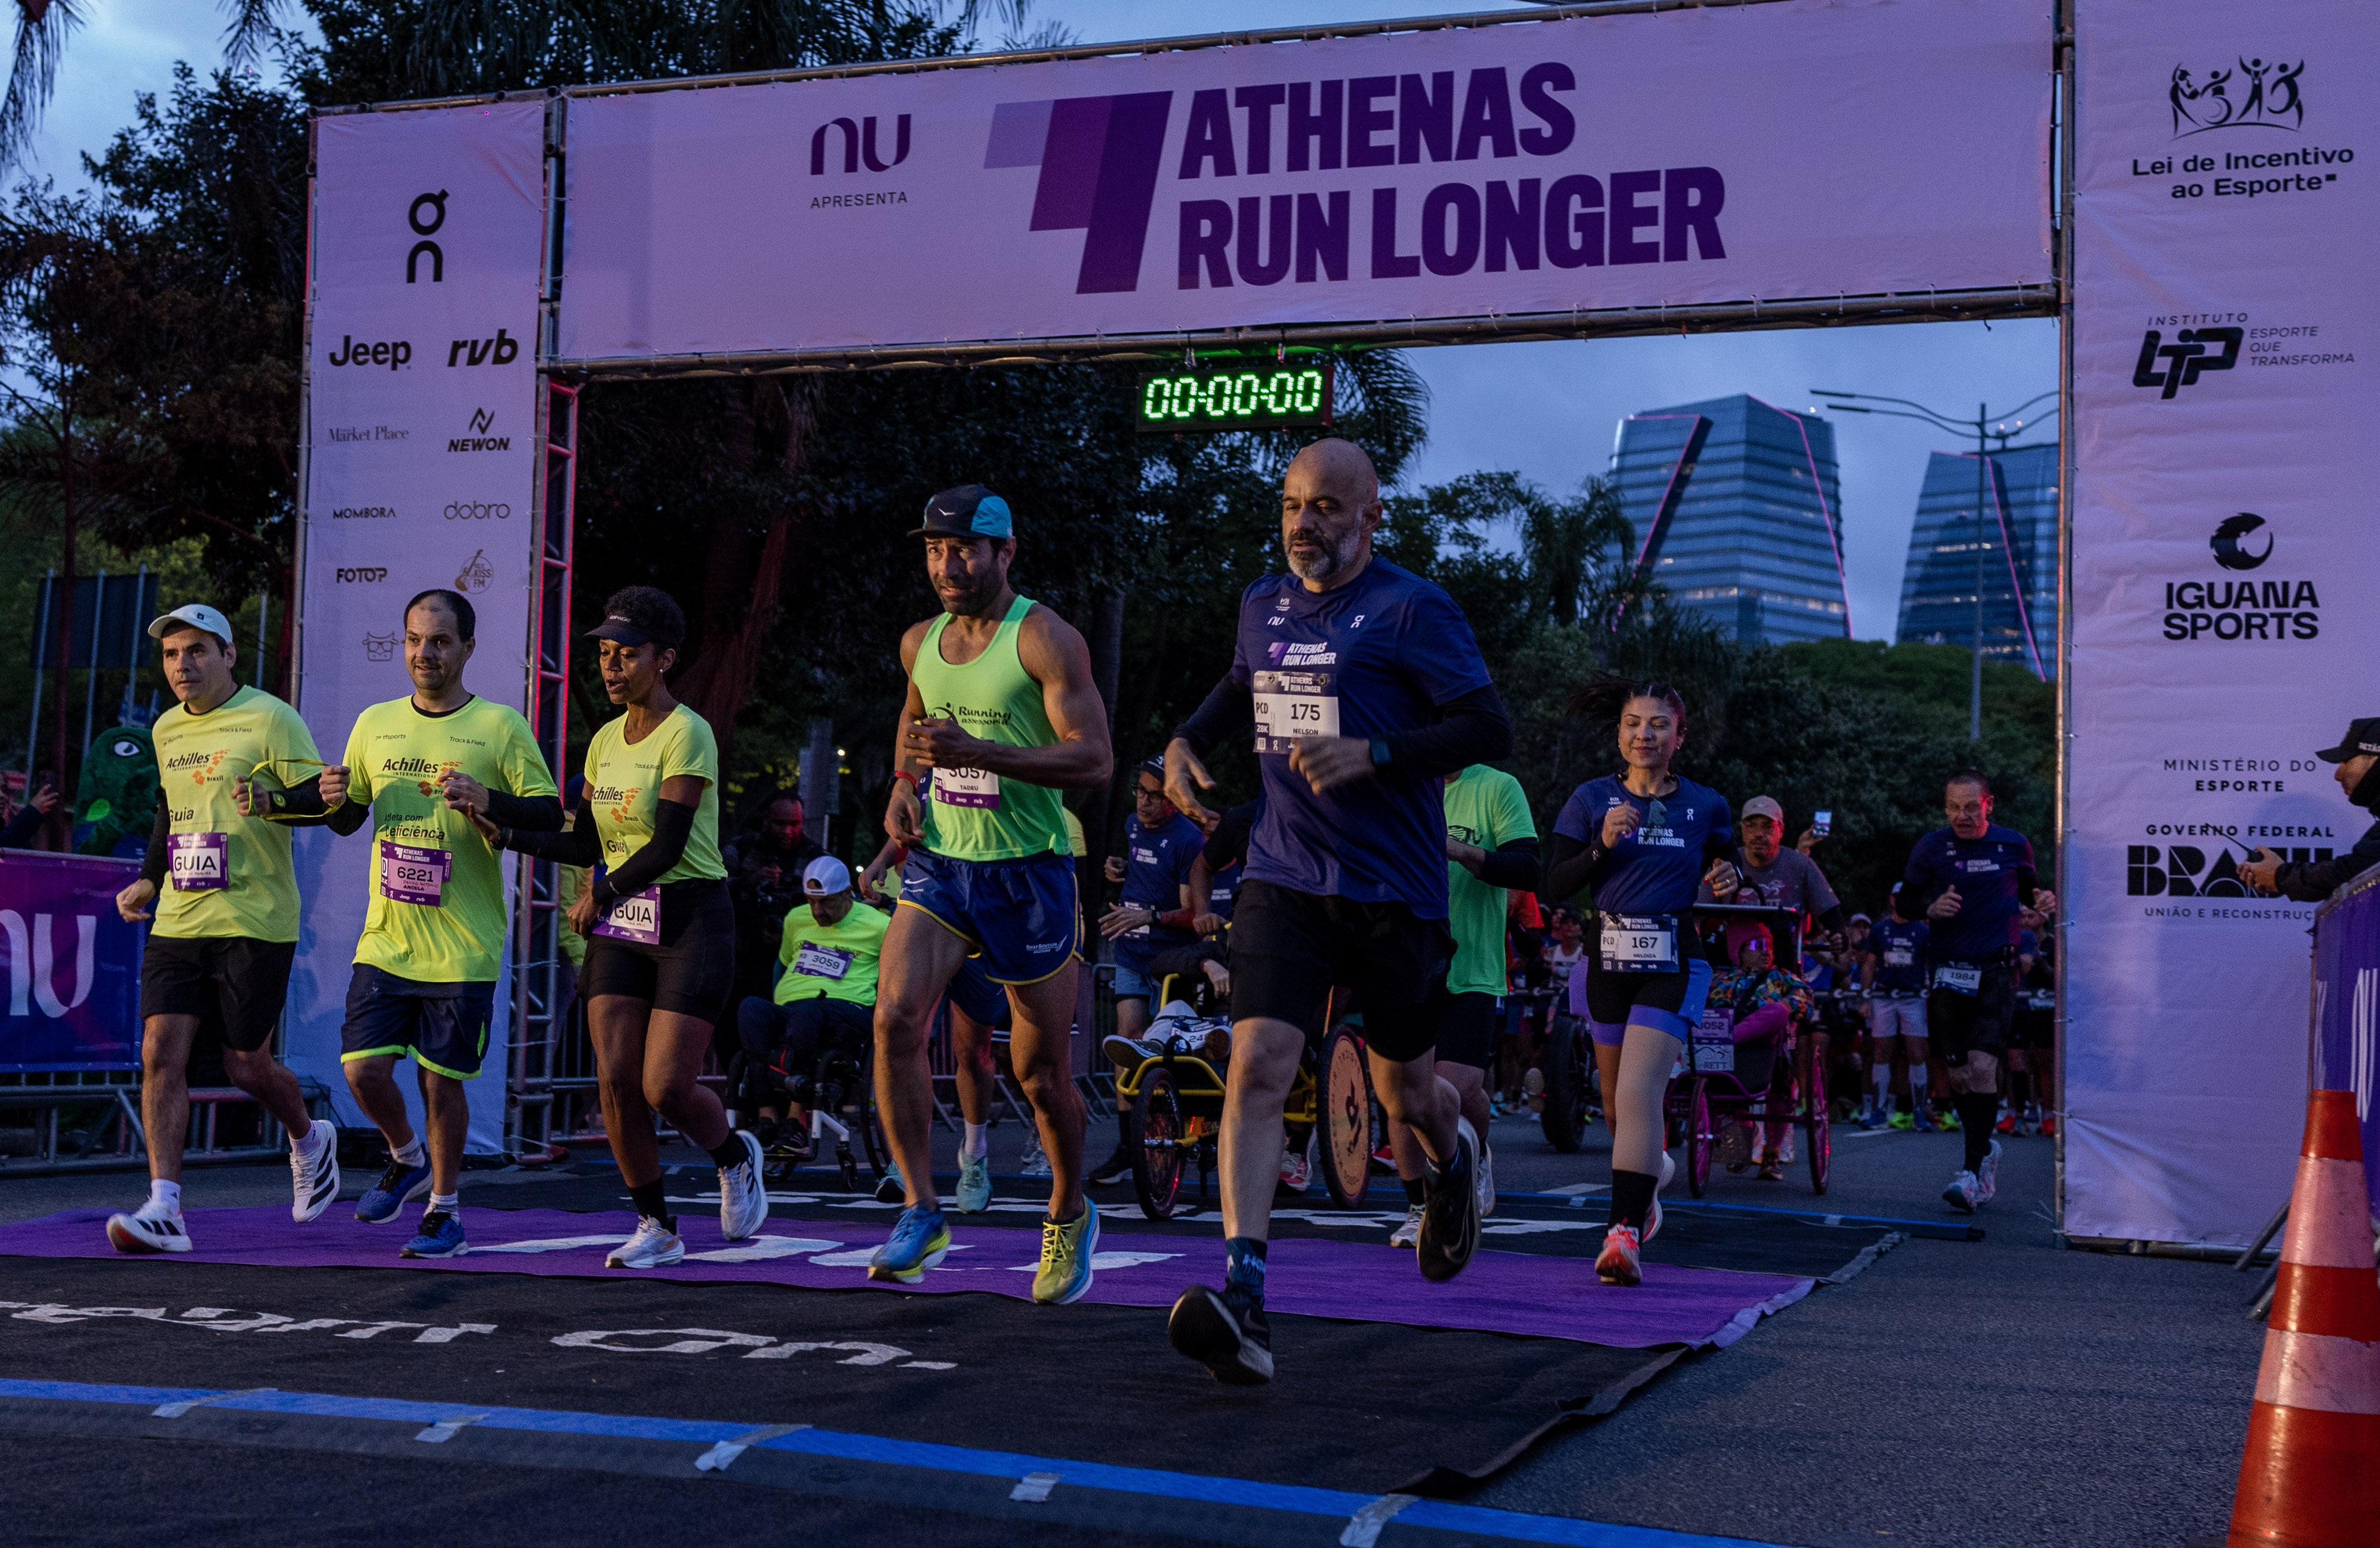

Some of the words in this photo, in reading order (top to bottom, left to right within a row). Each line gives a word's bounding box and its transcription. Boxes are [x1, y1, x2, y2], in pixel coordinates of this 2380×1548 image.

[1178, 61, 1576, 180] ATHENAS
[2132, 156, 2173, 176] Lei
[2183, 155, 2215, 173] de
[2225, 146, 2355, 170] Incentivo
[2171, 182, 2203, 199] ao
[2214, 173, 2323, 198] Esporte
[810, 190, 908, 210] APRESENTA
[1178, 190, 1350, 290] RUN
[1371, 166, 1726, 280] LONGER
[2147, 312, 2249, 326] INSTITUTO
[2249, 326, 2319, 339] ESPORTE
[328, 335, 412, 371] Jeep
[447, 328, 519, 368] rvb
[2249, 341, 2282, 354] QUE
[2249, 352, 2356, 367] TRANSFORMA
[328, 426, 371, 442] Market
[375, 425, 410, 441] Place
[447, 437, 510, 452] NEWON
[332, 507, 397, 519] MOMBORA
[443, 500, 511, 520] dobro
[336, 567, 388, 584] FOTOP
[2165, 580, 2320, 610] IGUANA
[2162, 611, 2319, 641] SPORTS
[1287, 641, 1328, 654] ATHENAS
[1281, 654, 1302, 667] RUN
[1301, 652, 1337, 666] LONGER
[1290, 675, 1313, 685] ATHENAS
[1290, 684, 1302, 693] RUN
[1301, 684, 1322, 694] LONGER
[958, 706, 1012, 721] Running
[1256, 702, 1269, 715] PCD
[1290, 703, 1321, 721] 175
[961, 717, 1010, 726] assessoria
[1292, 727, 1319, 736] NELSON
[165, 751, 211, 770] Achilles
[382, 757, 439, 774] Achilles
[2164, 757, 2281, 773] MINISTÉRIO
[2290, 758, 2317, 773] DO
[393, 771, 437, 779] INTERNATIONAL
[2195, 780, 2285, 793] ESPORTE
[168, 806, 195, 823] Guia
[405, 814, 424, 822] com
[386, 825, 446, 840] Deficiência
[1638, 827, 1674, 837] ATENAS
[2146, 824, 2239, 837] GOVERNO
[2247, 825, 2334, 838] FEDERAL
[1655, 836, 1685, 848] LONGER
[402, 848, 424, 856] ATHENAS
[174, 855, 217, 872] GUIA
[397, 866, 434, 883] 6221
[2127, 844, 2334, 899] BRA
[614, 902, 653, 924] GUIA
[2144, 906, 2192, 919] UNIÃO
[2197, 908, 2206, 919] E
[1602, 936, 1615, 945] PCD
[1631, 936, 1658, 949] 167
[812, 955, 840, 970] 3059
[1949, 971, 1975, 982] 1984
[1189, 1034, 1207, 1044] 24
